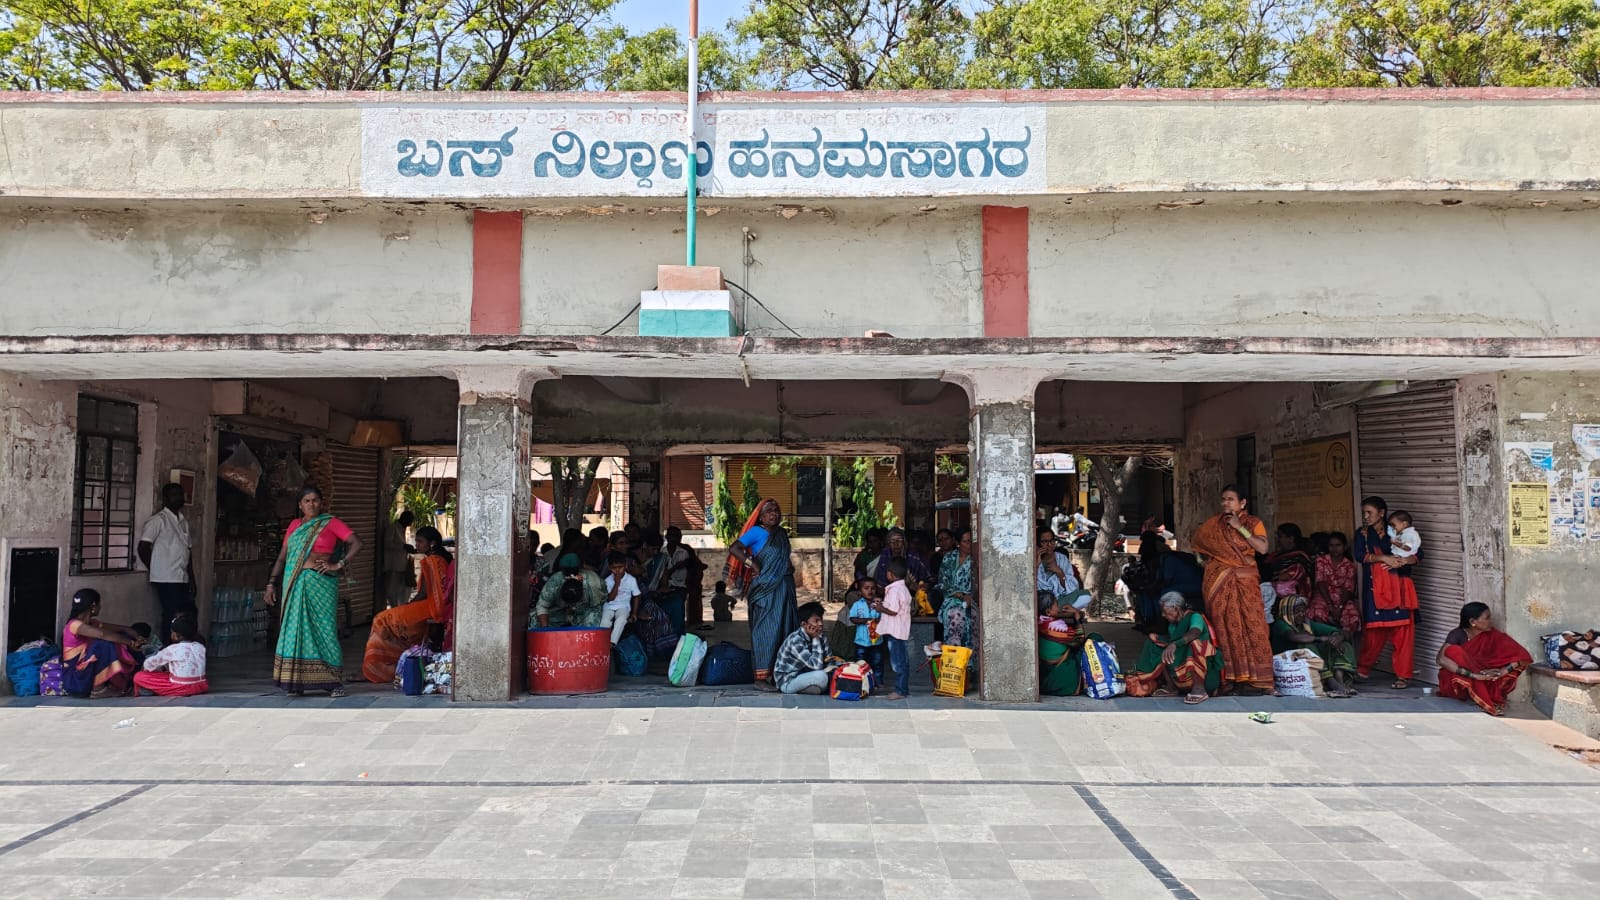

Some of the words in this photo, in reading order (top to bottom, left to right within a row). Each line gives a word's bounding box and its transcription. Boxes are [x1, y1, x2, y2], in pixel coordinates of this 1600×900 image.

[396, 126, 518, 178] ಬಸ್
[533, 130, 713, 188] ನಿಲ್ದಾಣ
[728, 126, 1031, 178] ಹನಮಸಾಗರ
